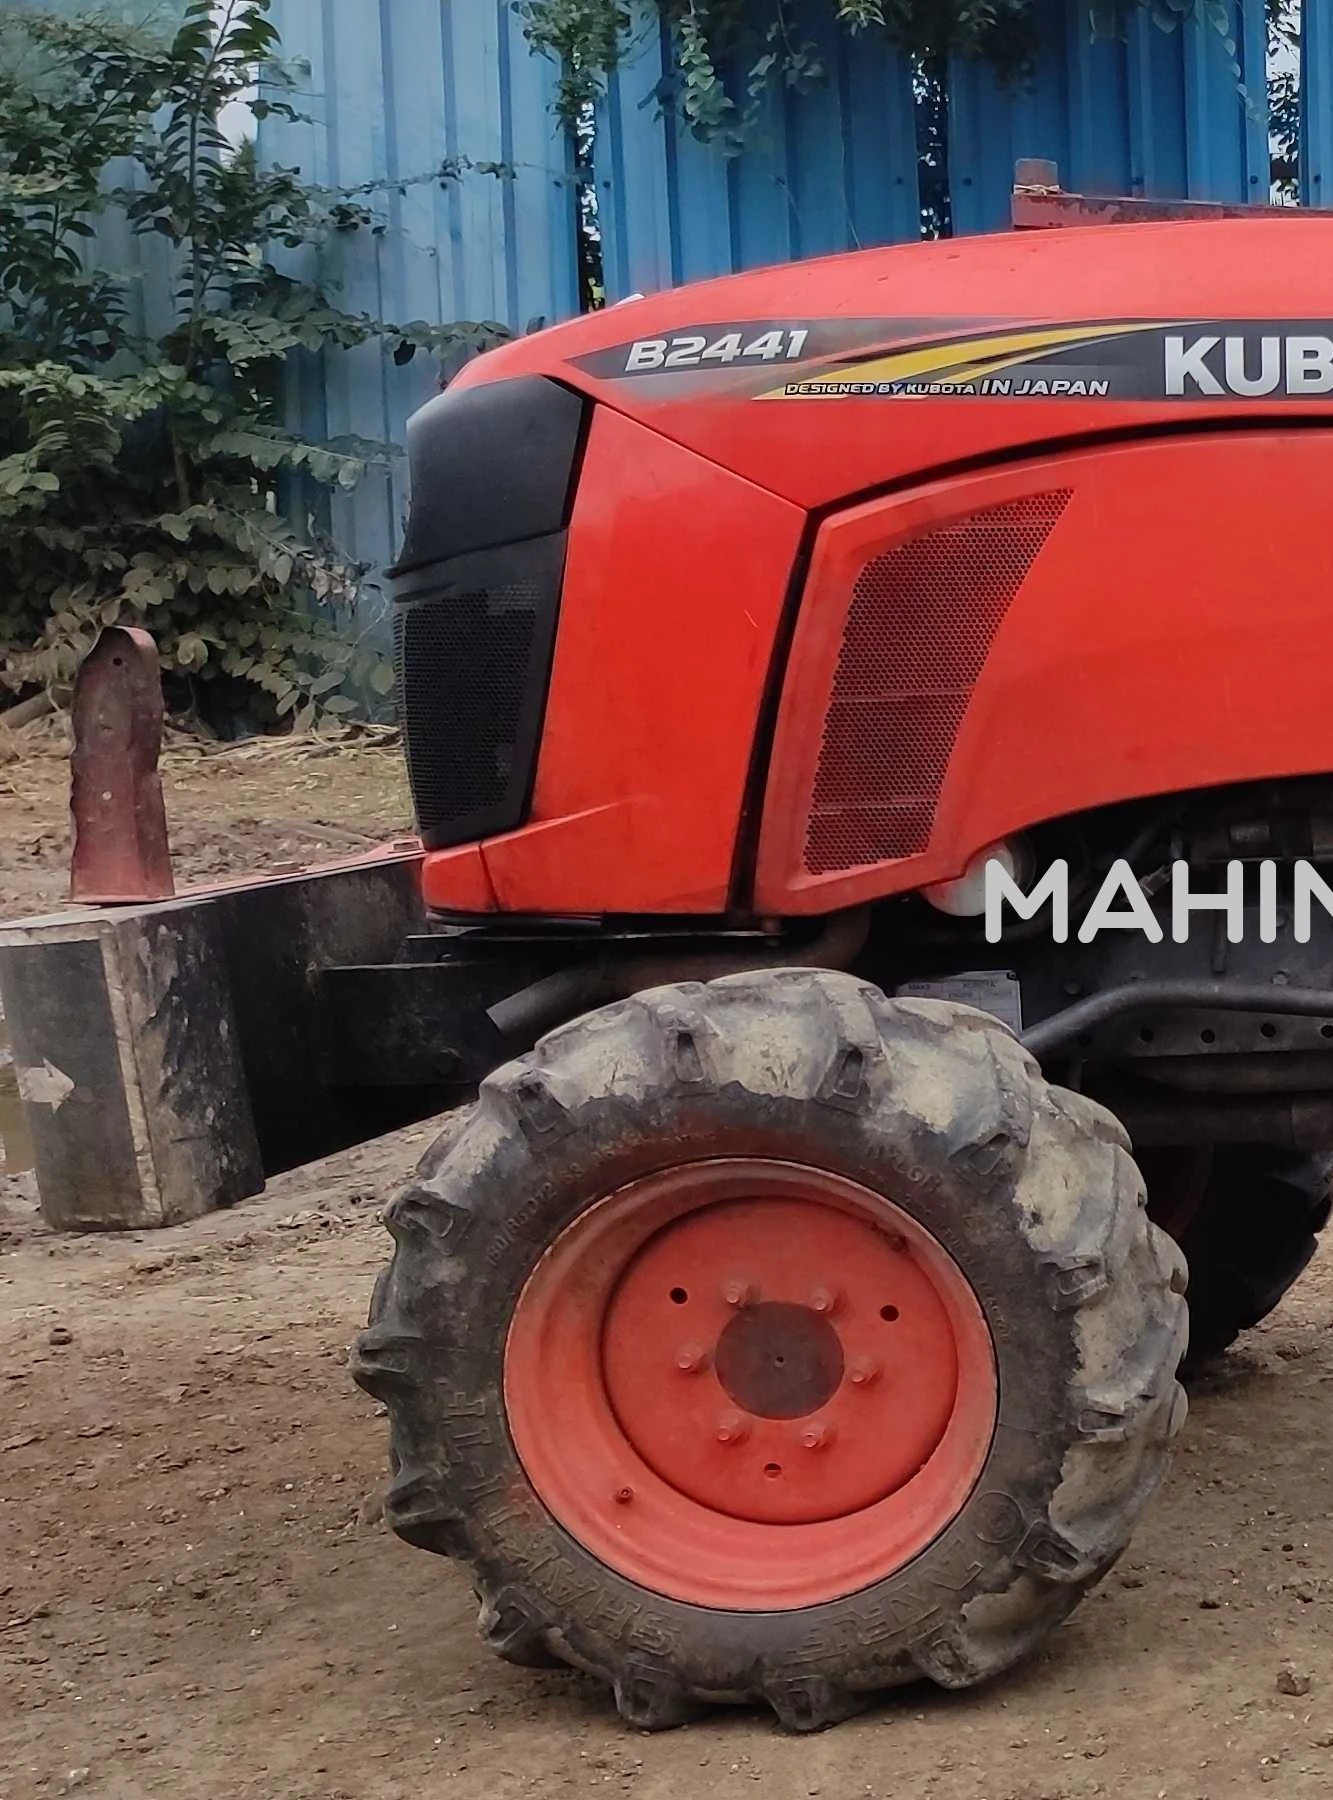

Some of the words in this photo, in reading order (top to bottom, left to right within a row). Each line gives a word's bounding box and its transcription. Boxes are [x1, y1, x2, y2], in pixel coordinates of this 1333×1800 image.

[625, 330, 809, 372] B2441
[784, 382, 875, 395] DESIGNED
[877, 382, 903, 395] BY
[905, 382, 975, 395] KUBOTA
[981, 378, 1012, 395] IN
[1014, 379, 1109, 396] JAPAN
